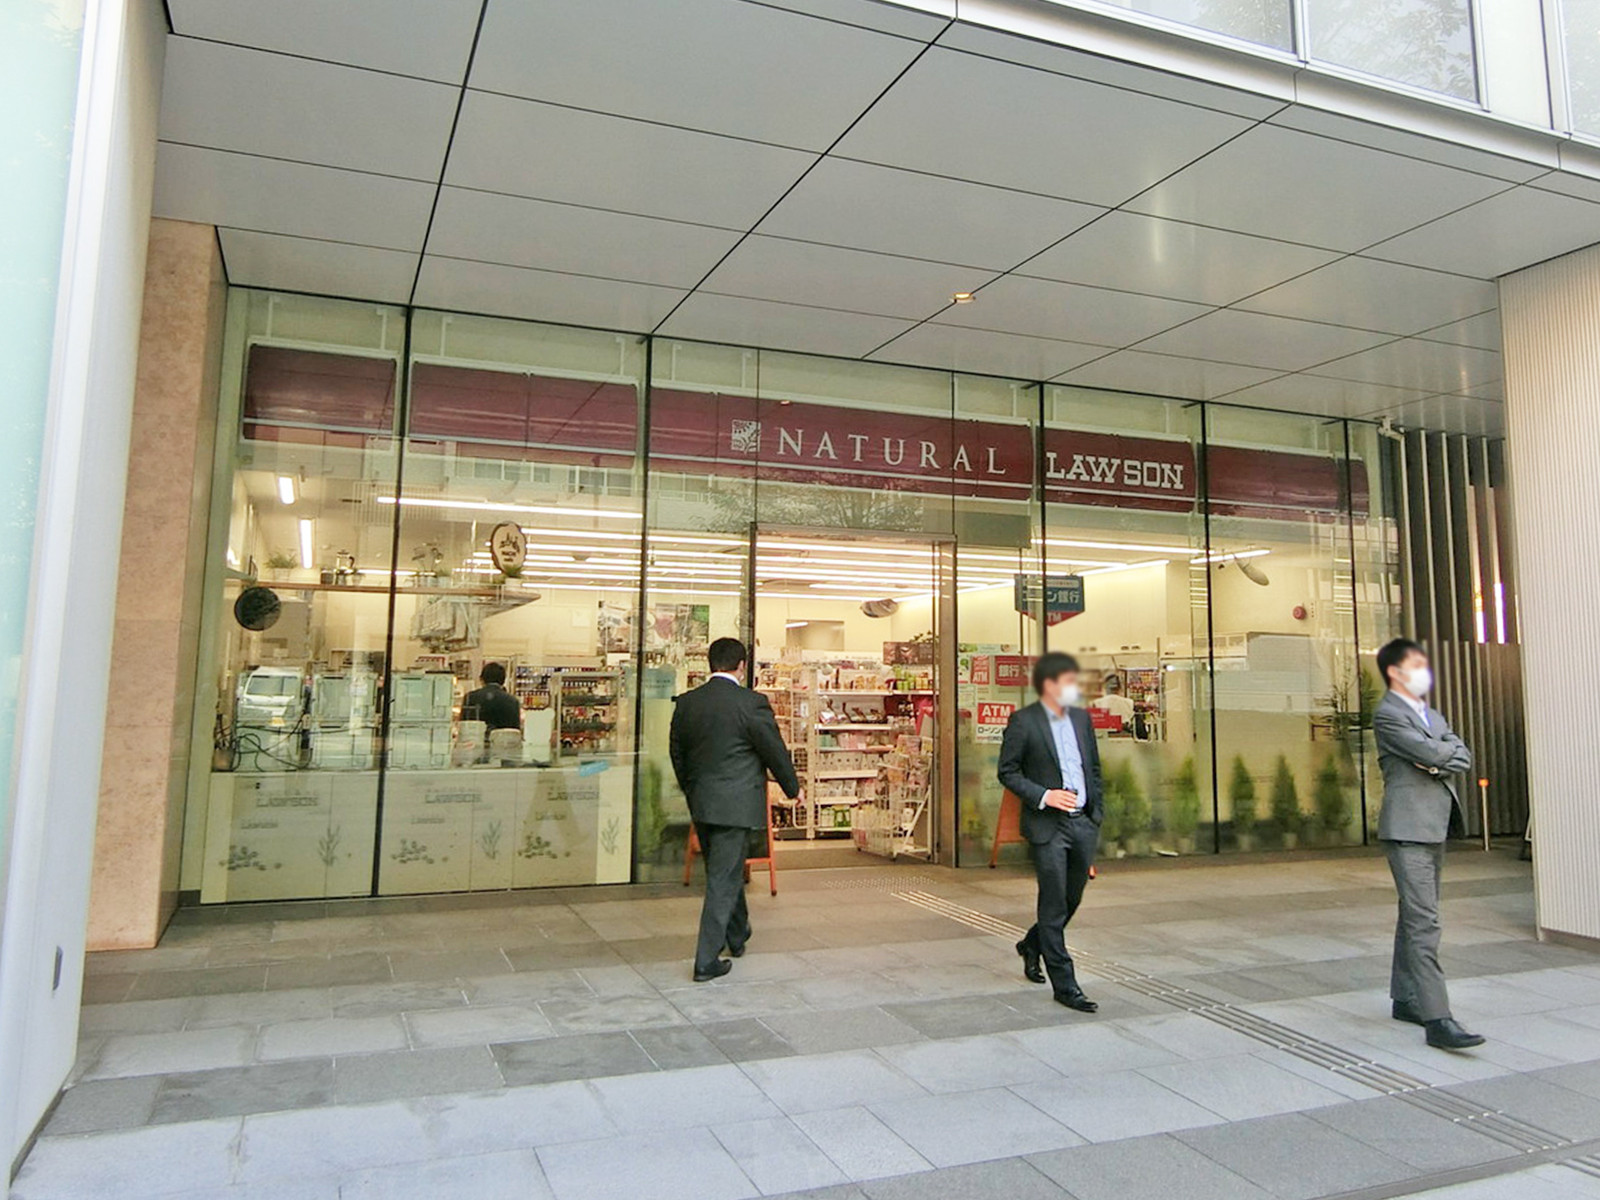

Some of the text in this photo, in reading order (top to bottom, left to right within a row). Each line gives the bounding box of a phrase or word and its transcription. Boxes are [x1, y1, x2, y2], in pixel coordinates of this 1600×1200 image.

[777, 427, 1184, 490] NATURAL LAWSON
[982, 705, 1011, 718] ATM
